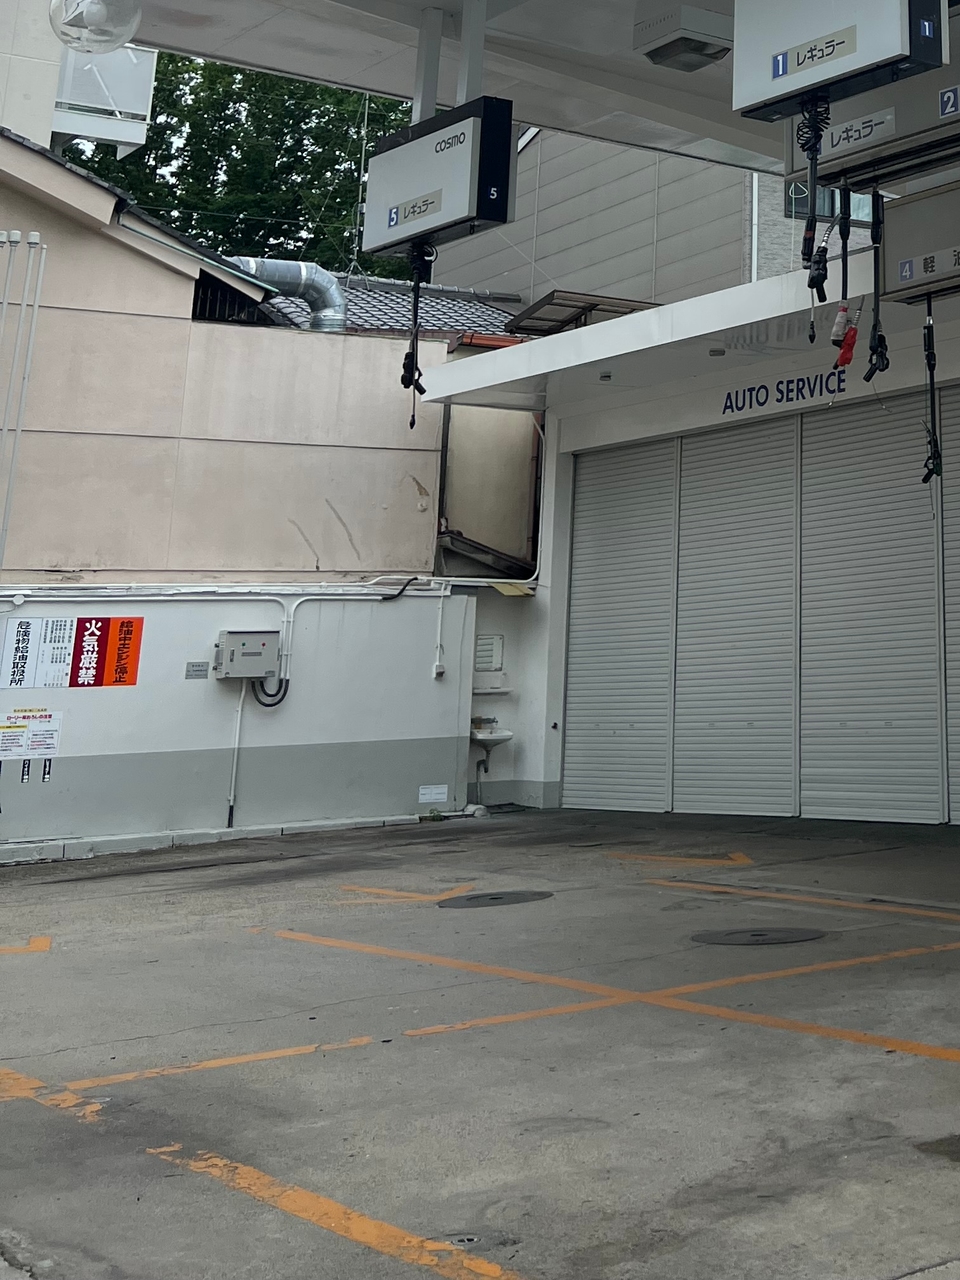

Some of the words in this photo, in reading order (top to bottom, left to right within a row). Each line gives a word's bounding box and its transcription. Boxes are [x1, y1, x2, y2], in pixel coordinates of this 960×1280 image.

[924, 21, 930, 36] 1
[777, 54, 783, 76] 1
[796, 39, 845, 67] レギュラー
[944, 91, 956, 113] 2
[434, 132, 466, 154] COSMO
[831, 119, 885, 149] レギュラー
[489, 187, 498, 199] 5
[389, 208, 398, 225] 5
[403, 199, 435, 219] レギュラー
[901, 263, 911, 279] 4
[722, 384, 769, 415] AUTO
[775, 369, 846, 403] SERVICE
[9, 620, 32, 686] 危険物給油取扱所
[77, 619, 103, 685] 火気厳禁
[112, 620, 135, 684] 給油中エンジン停止
